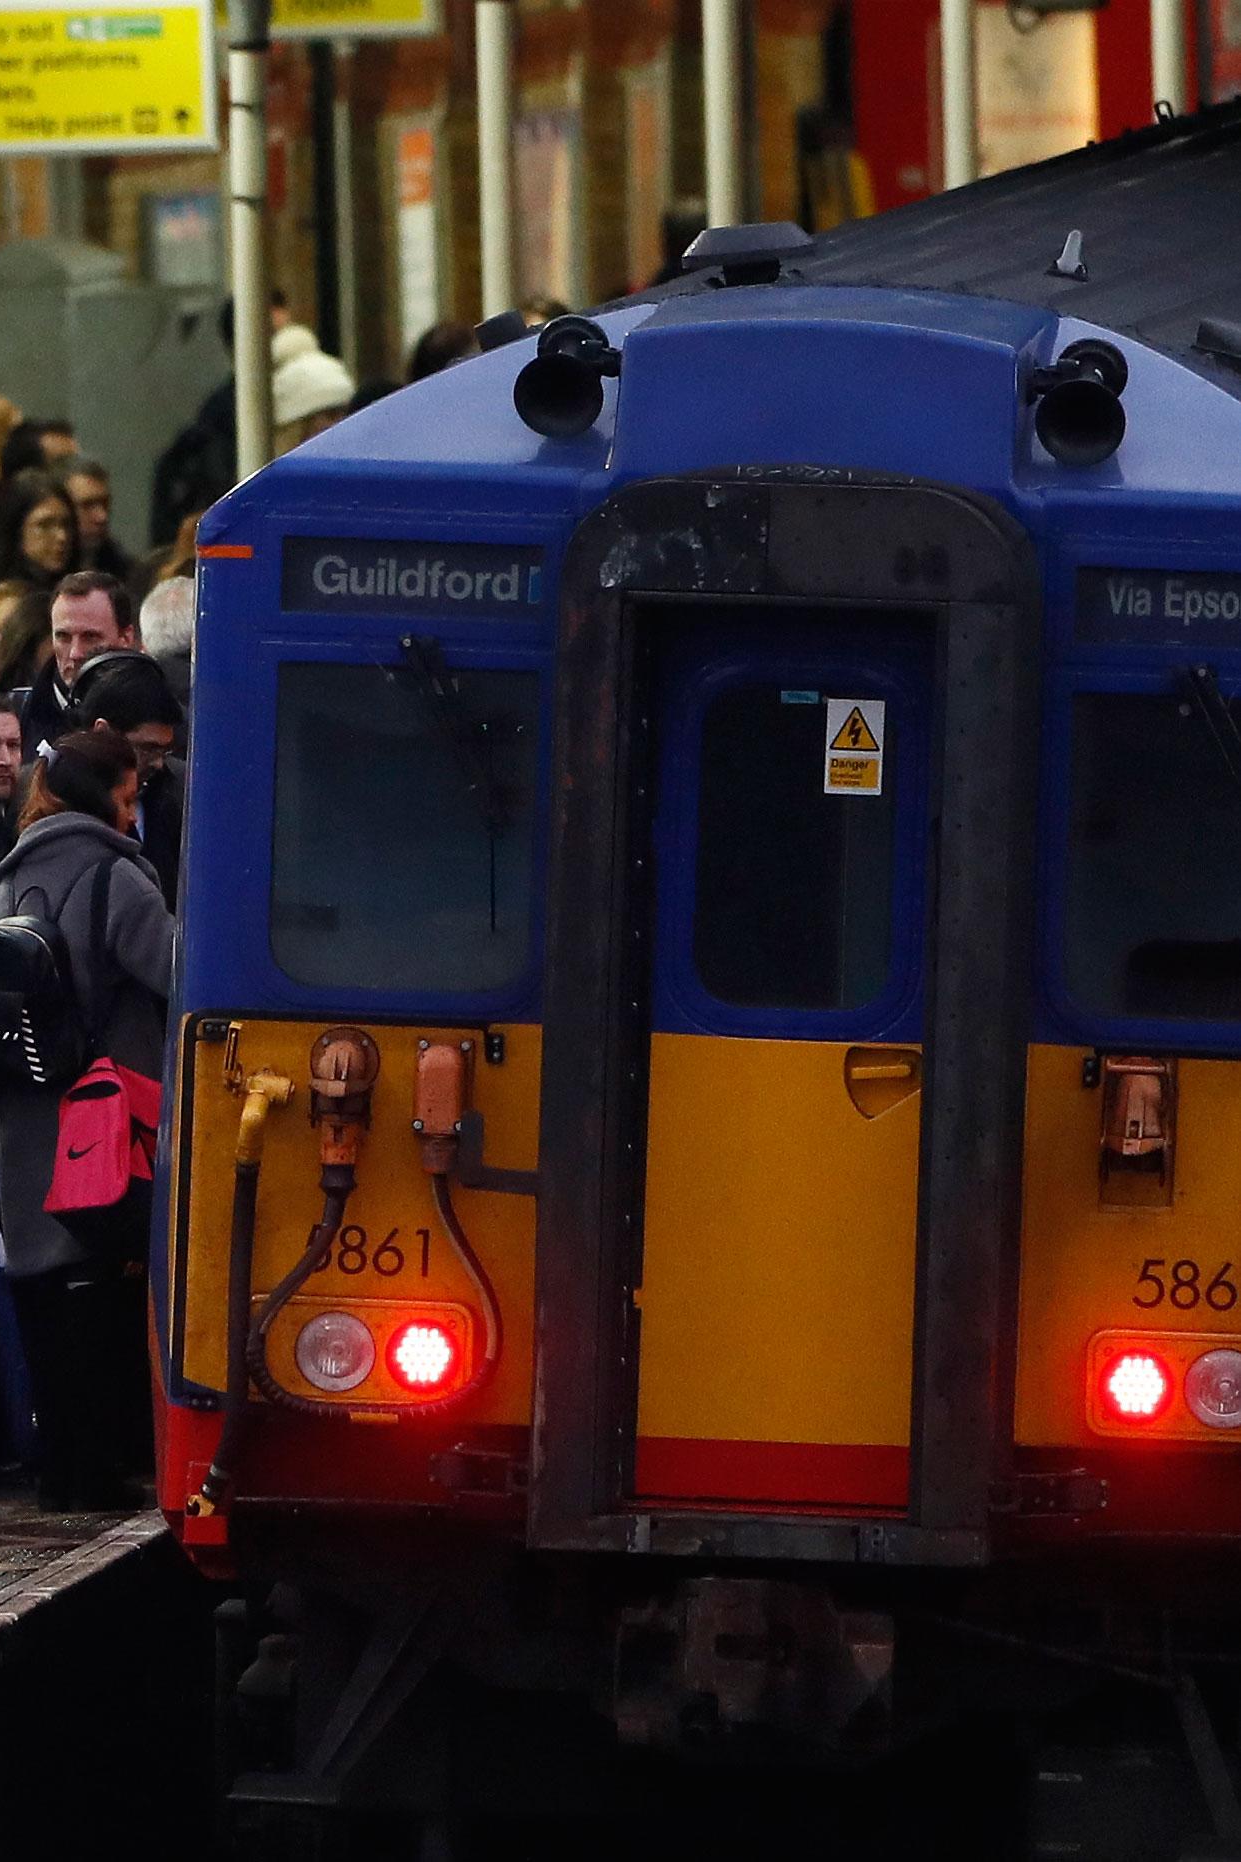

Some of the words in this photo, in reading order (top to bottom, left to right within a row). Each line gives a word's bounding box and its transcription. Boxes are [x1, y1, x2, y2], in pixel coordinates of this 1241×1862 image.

[312, 554, 520, 602] Guildford
[1108, 576, 1152, 617] Via
[1164, 578, 1241, 626] Epso
[831, 758, 869, 771] Danger
[1132, 1258, 1238, 1311] 586
